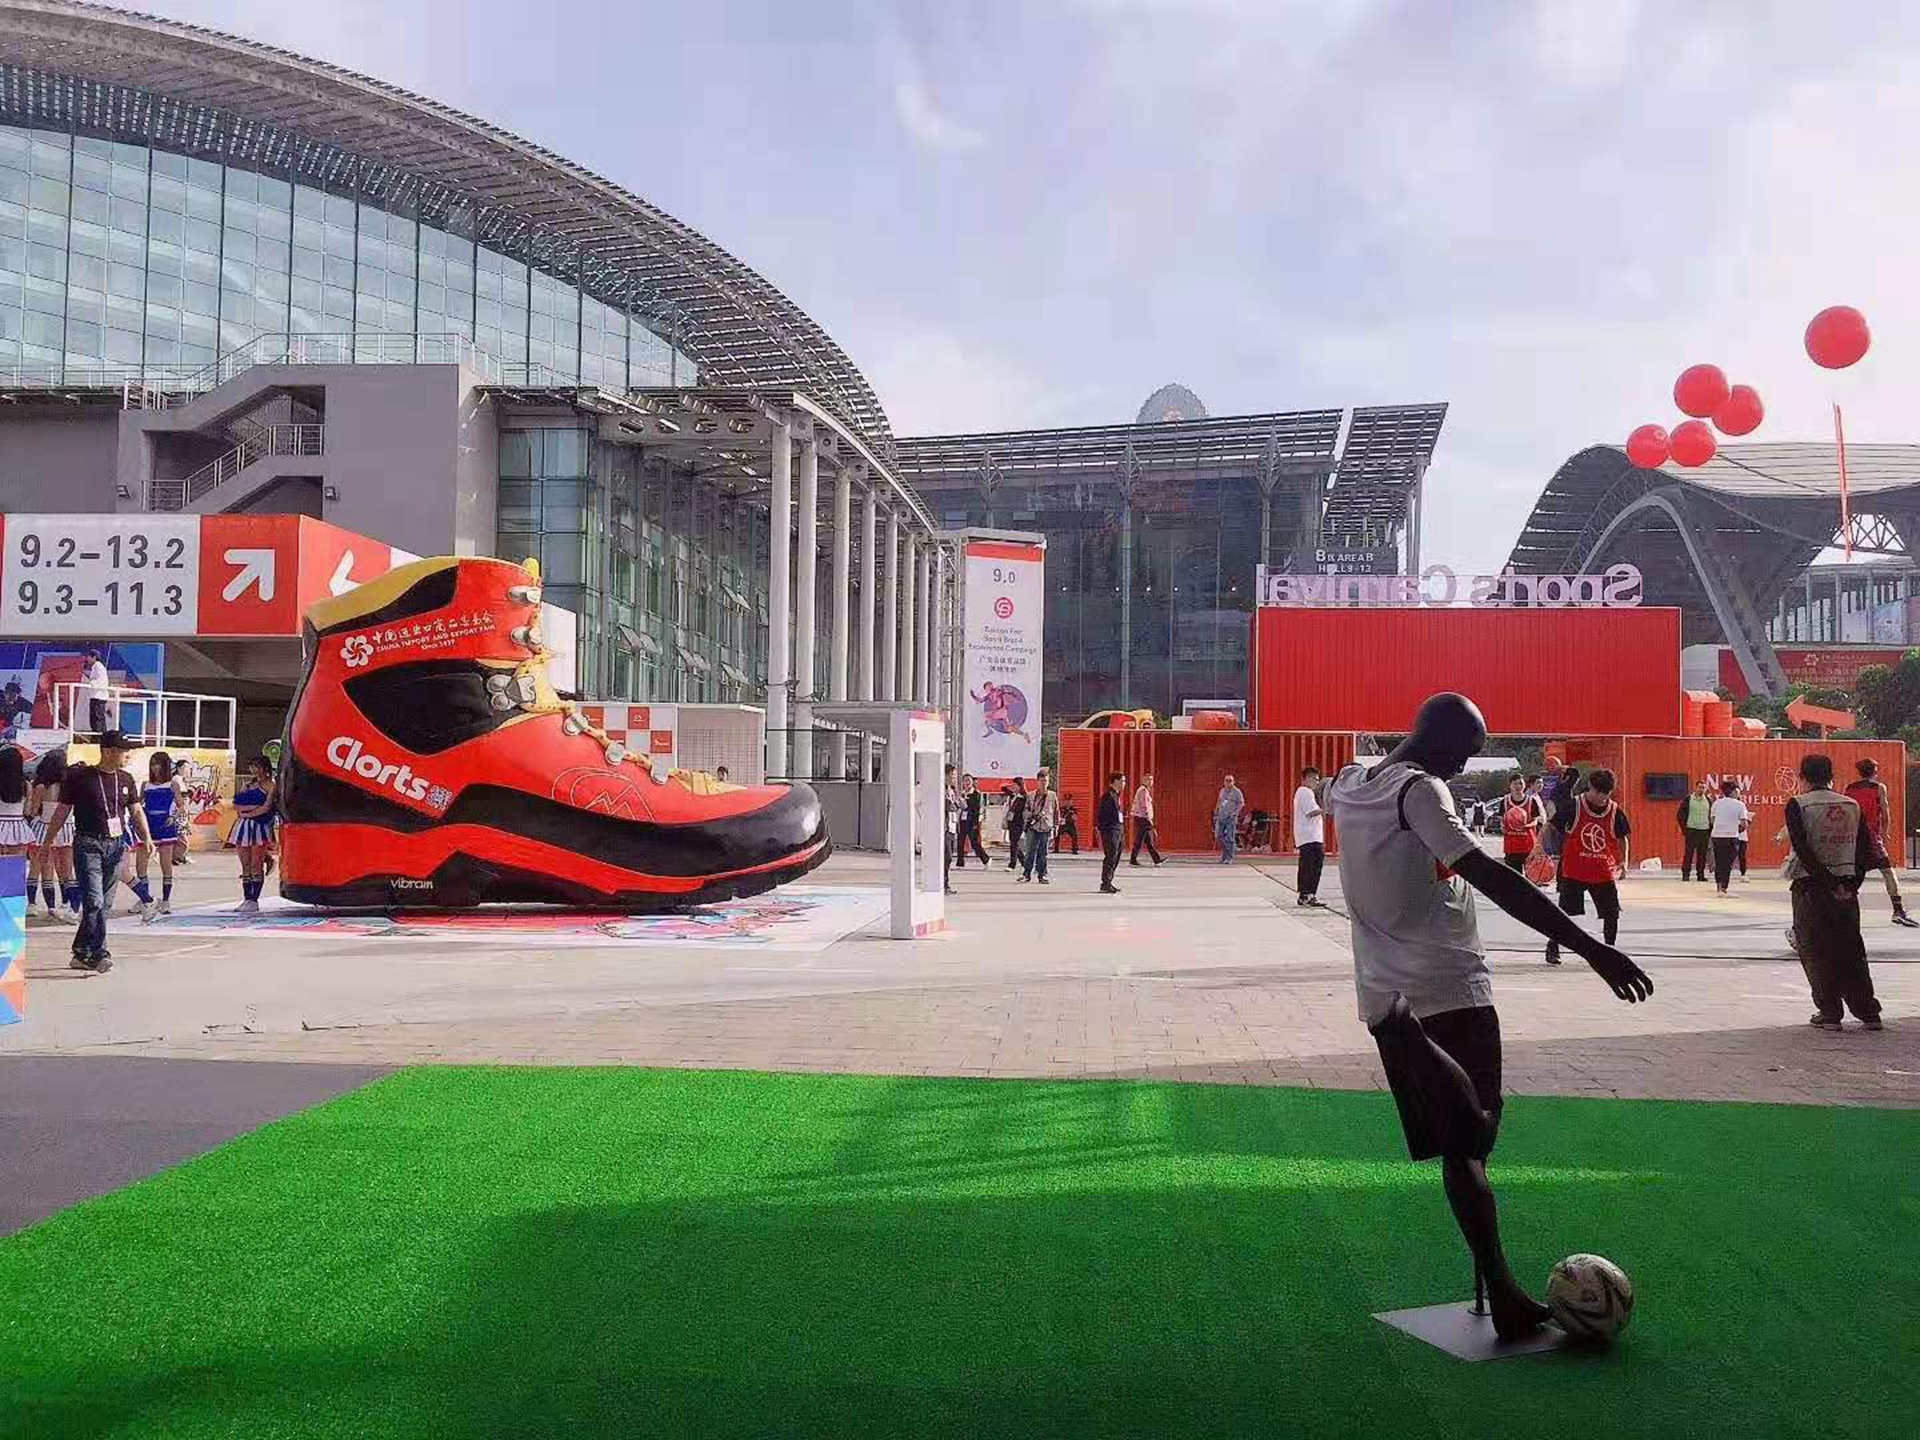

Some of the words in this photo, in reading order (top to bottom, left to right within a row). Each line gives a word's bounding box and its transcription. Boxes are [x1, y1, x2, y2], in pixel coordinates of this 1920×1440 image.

[20, 534, 185, 569] 9.2-13.2
[993, 568, 1016, 584] 9.0
[18, 580, 183, 615] 9.3-11.3
[327, 736, 430, 801] Clorts
[390, 877, 434, 890] vibram
